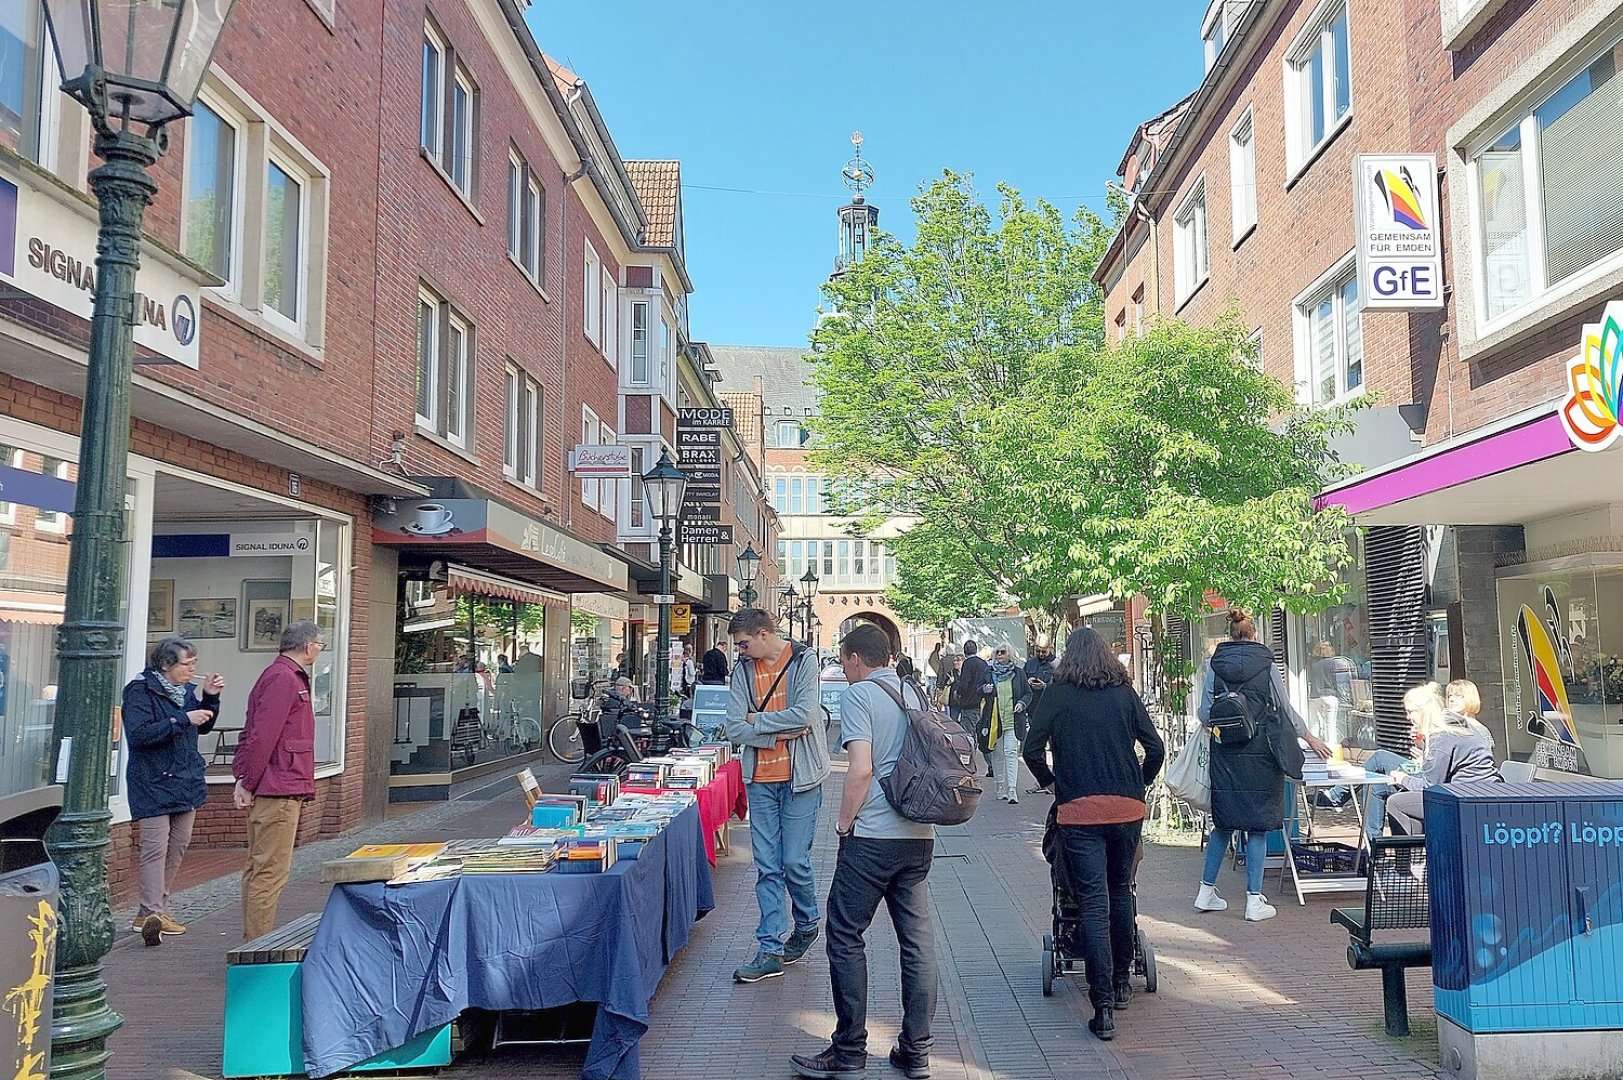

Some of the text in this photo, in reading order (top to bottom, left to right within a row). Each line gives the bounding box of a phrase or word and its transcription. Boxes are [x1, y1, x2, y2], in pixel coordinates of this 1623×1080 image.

[1370, 233, 1432, 241] GEMEINSAM
[1370, 243, 1432, 252] FÜR EMDEN
[28, 237, 95, 295] SIGNA
[1373, 265, 1432, 296] GfE
[681, 408, 730, 420] MODE
[682, 434, 716, 442] RABE
[682, 450, 716, 459] BRAX
[681, 526, 719, 535] Damen
[681, 534, 718, 543] Herren
[721, 531, 729, 540] &
[236, 543, 266, 551] SIGNAL
[1483, 821, 1563, 849] Löppt?
